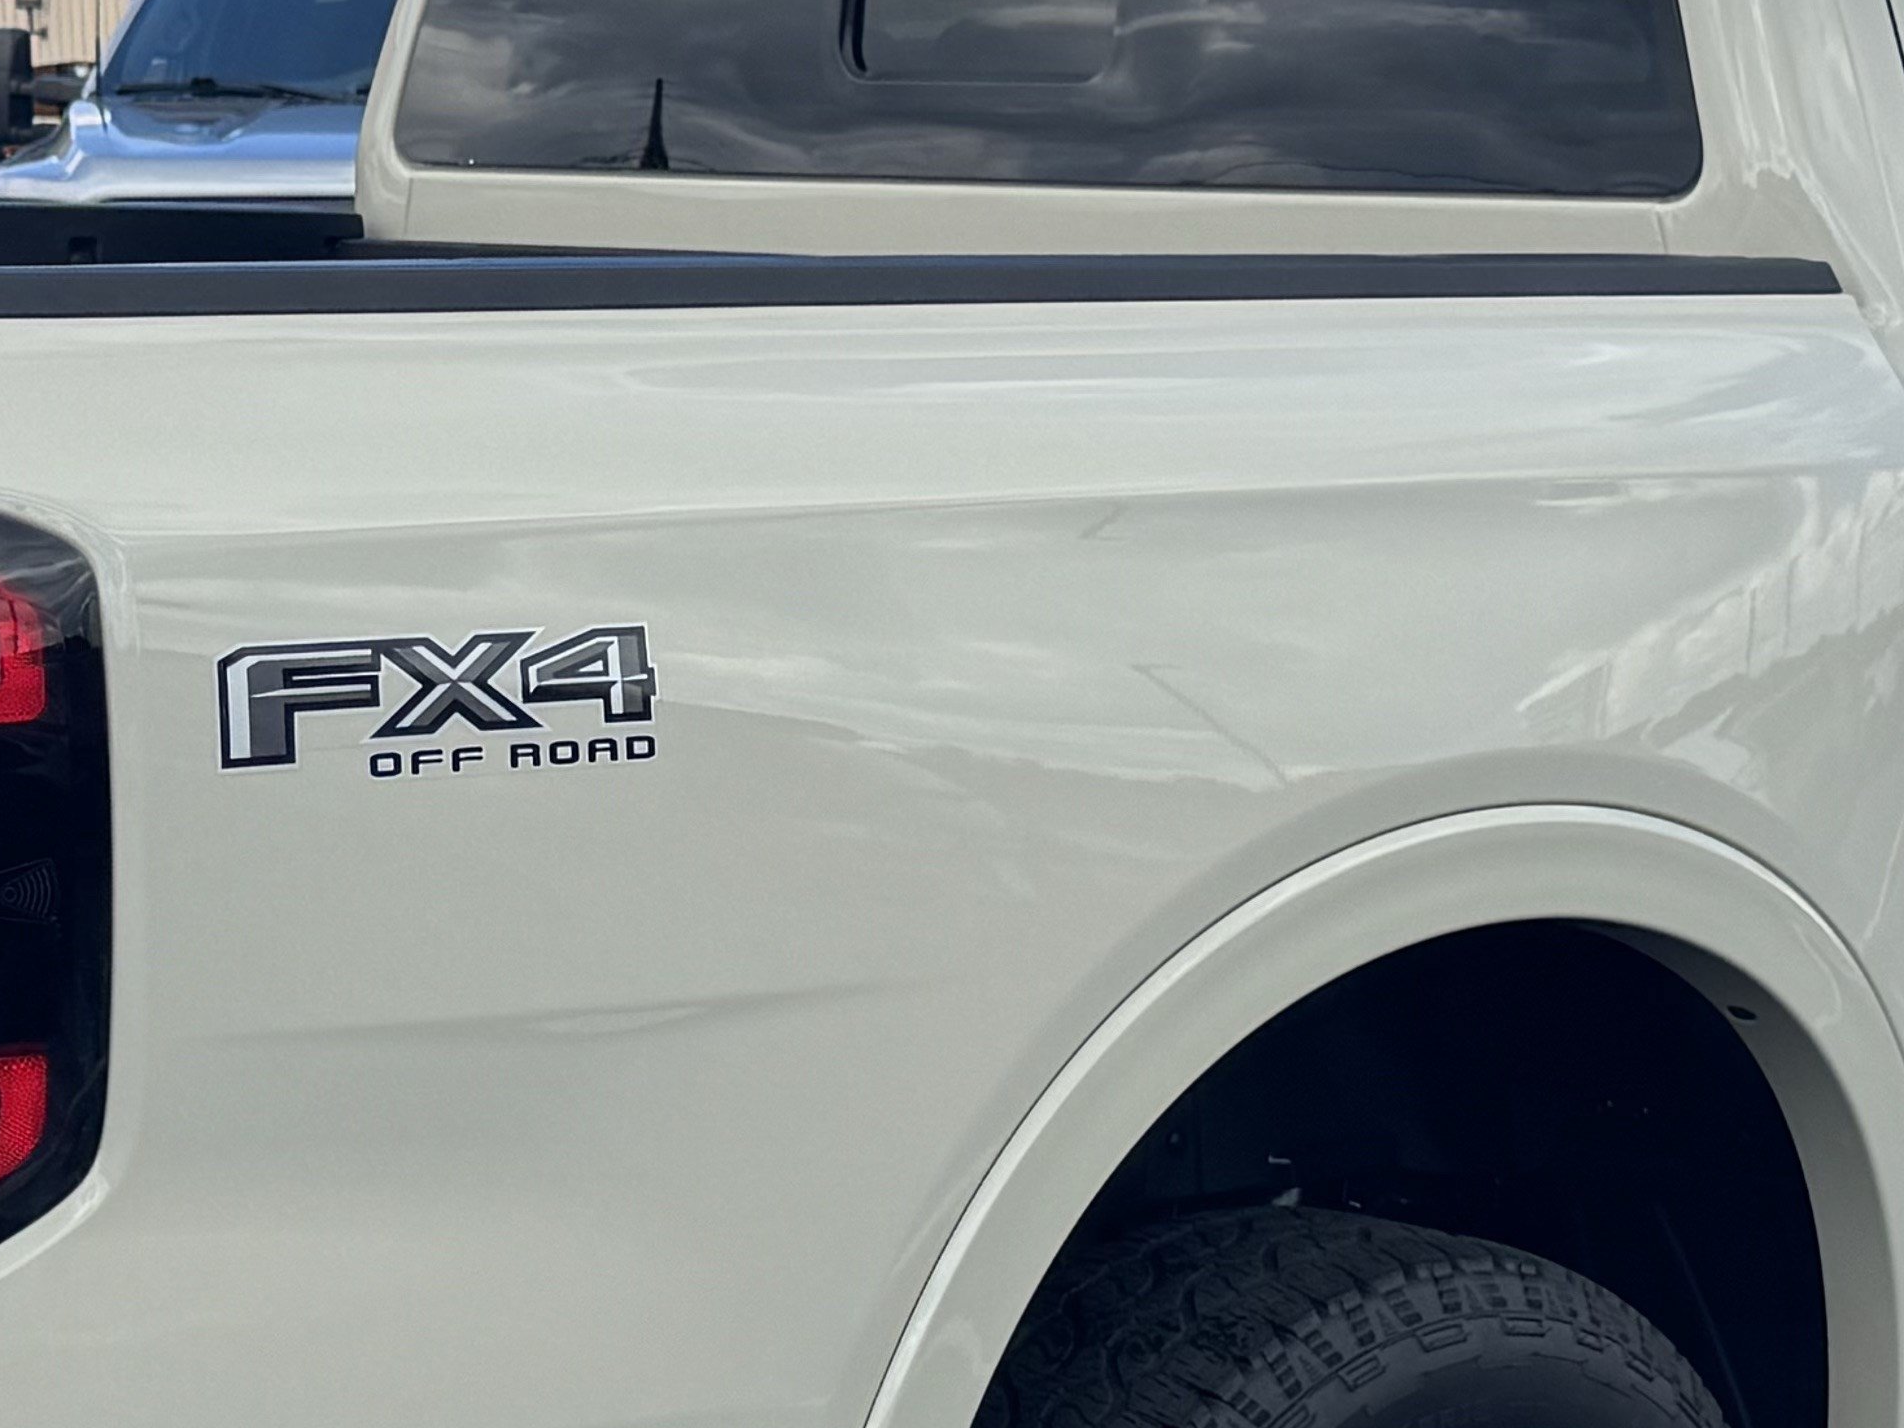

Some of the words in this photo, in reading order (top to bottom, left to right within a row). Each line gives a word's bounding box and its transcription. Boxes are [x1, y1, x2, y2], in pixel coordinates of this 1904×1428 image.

[215, 623, 657, 772] FX4
[369, 745, 485, 778] OFF
[509, 734, 657, 769] ROAD
